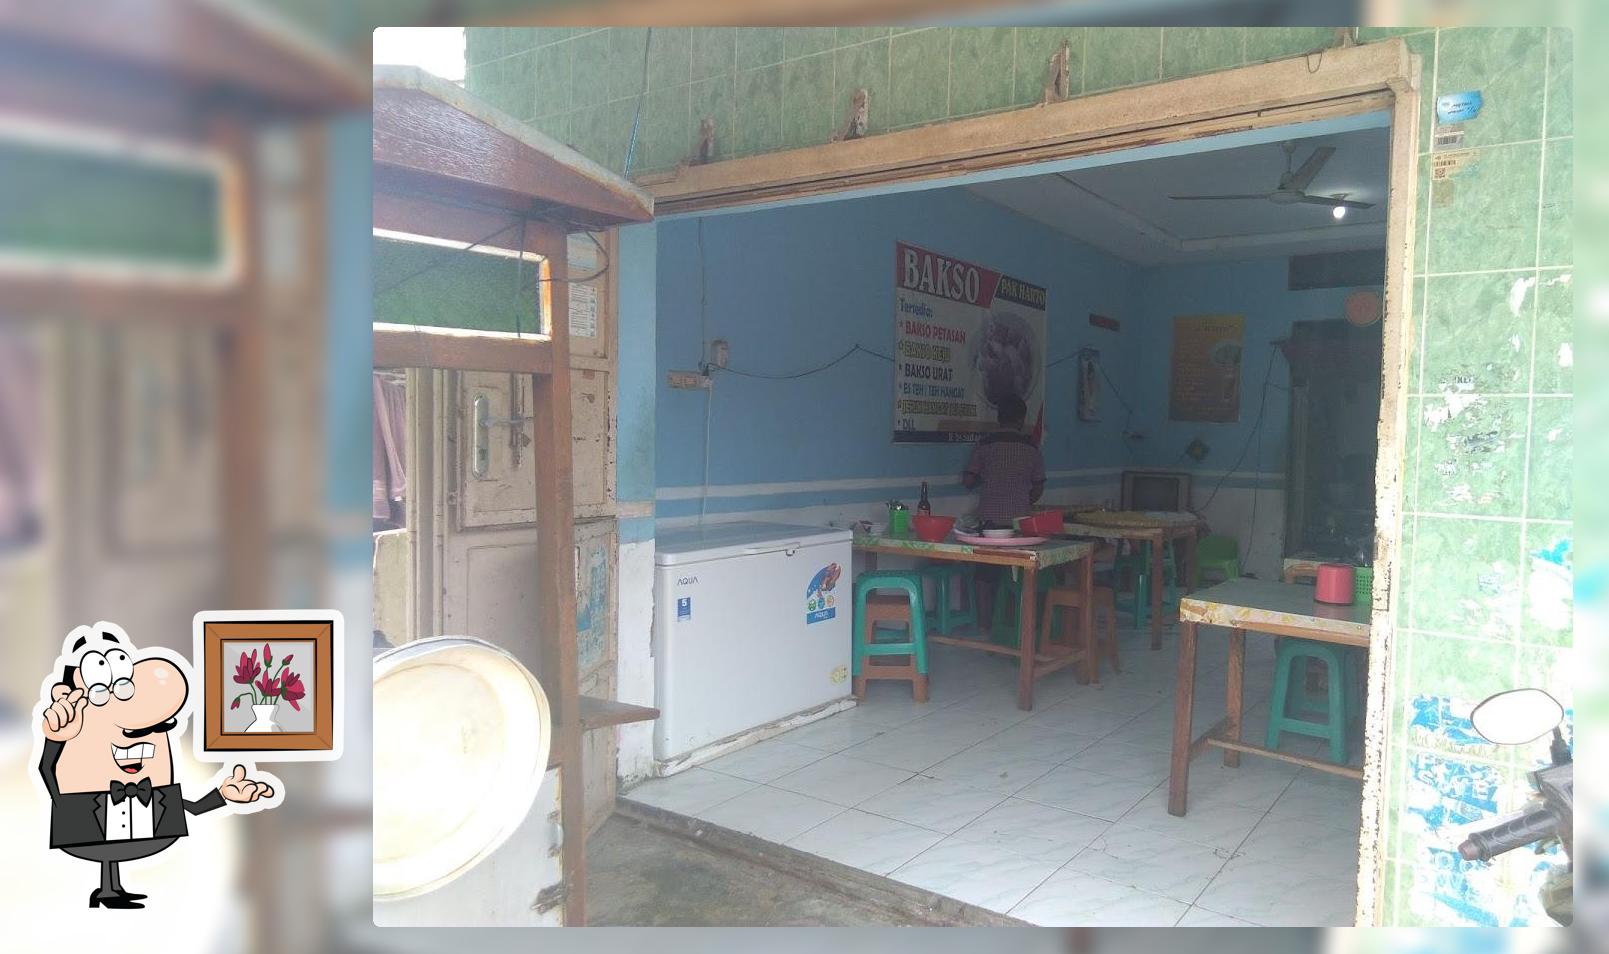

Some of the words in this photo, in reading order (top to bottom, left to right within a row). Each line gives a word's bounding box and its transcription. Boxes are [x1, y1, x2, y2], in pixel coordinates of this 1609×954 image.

[903, 248, 980, 304] BAKSO
[905, 320, 931, 338] BAKSO
[933, 326, 966, 344] PETASAN
[905, 363, 931, 378] BAKSO
[933, 366, 953, 382] URAT
[677, 576, 699, 586] AQUA
[681, 599, 688, 607] 5
